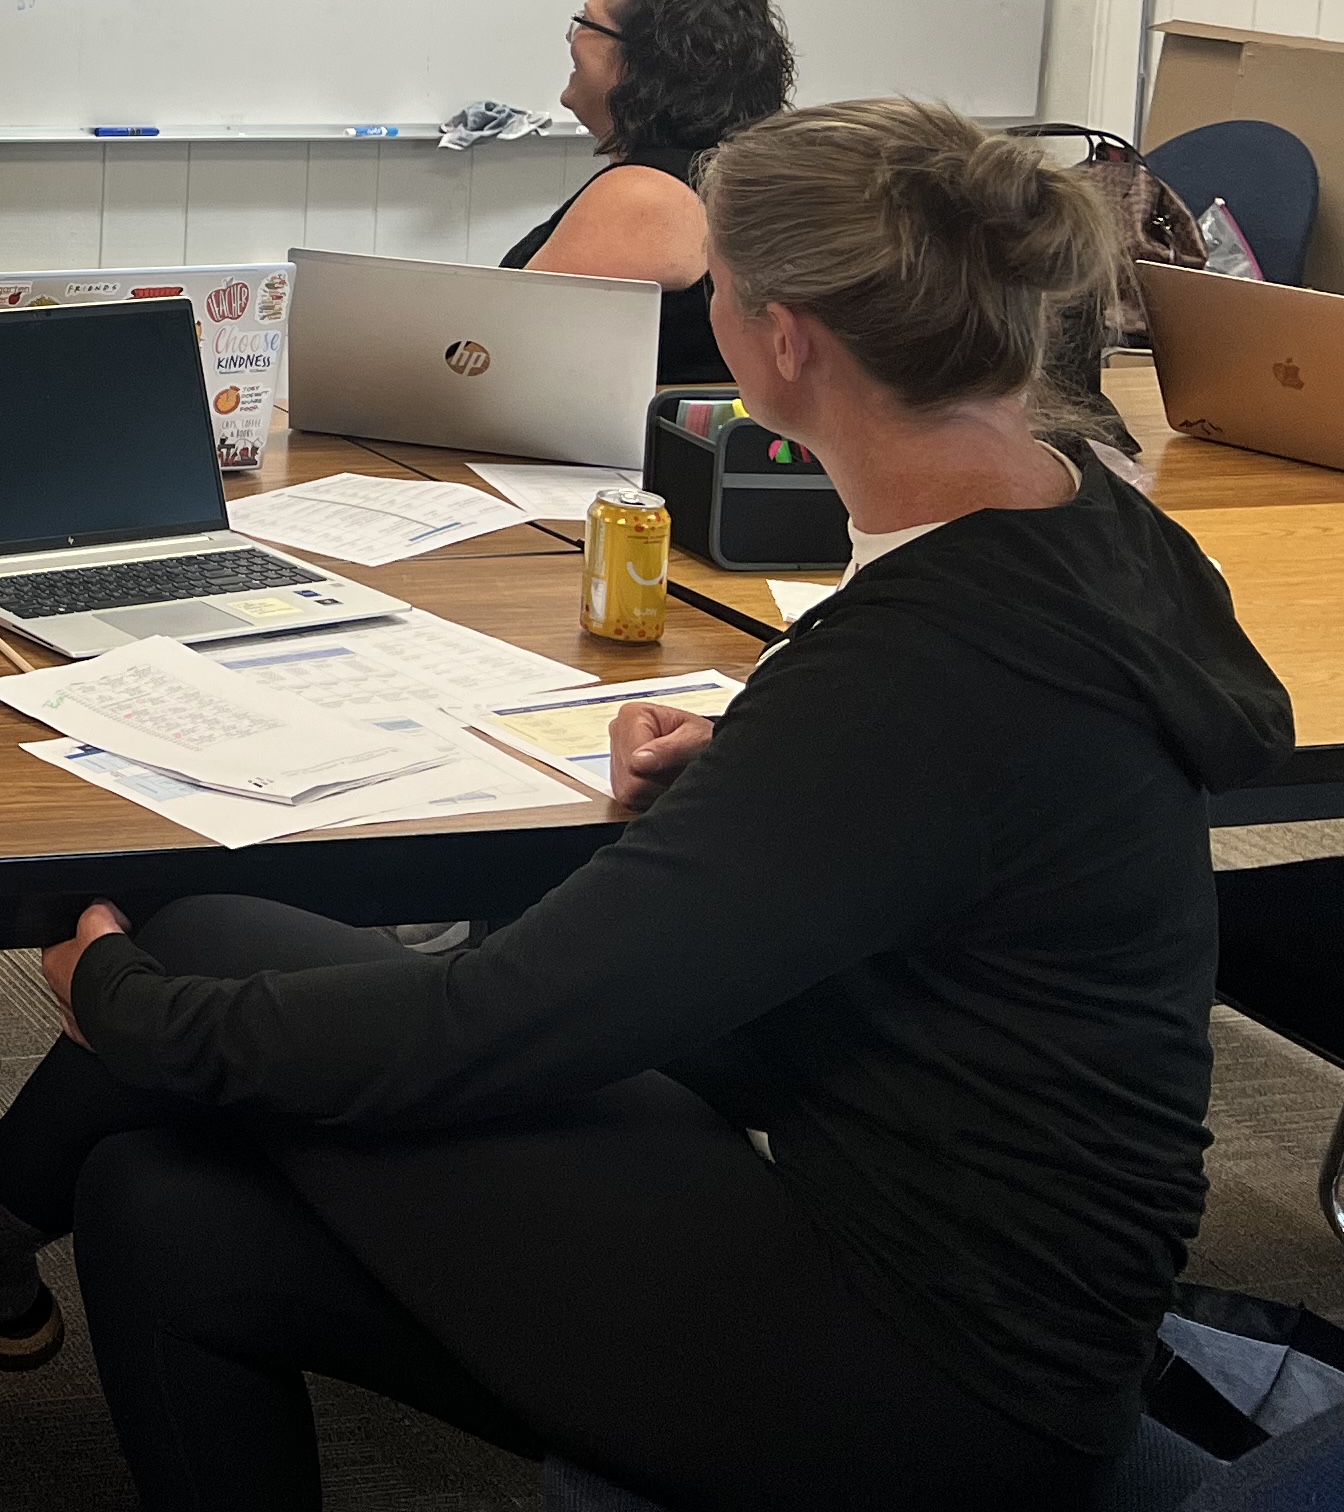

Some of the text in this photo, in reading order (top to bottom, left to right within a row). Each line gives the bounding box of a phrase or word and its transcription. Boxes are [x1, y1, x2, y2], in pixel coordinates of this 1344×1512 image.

[207, 283, 248, 321] TEACHER
[215, 326, 280, 355] Choose
[216, 353, 272, 370] KINDNESS
[450, 340, 488, 378] hp
